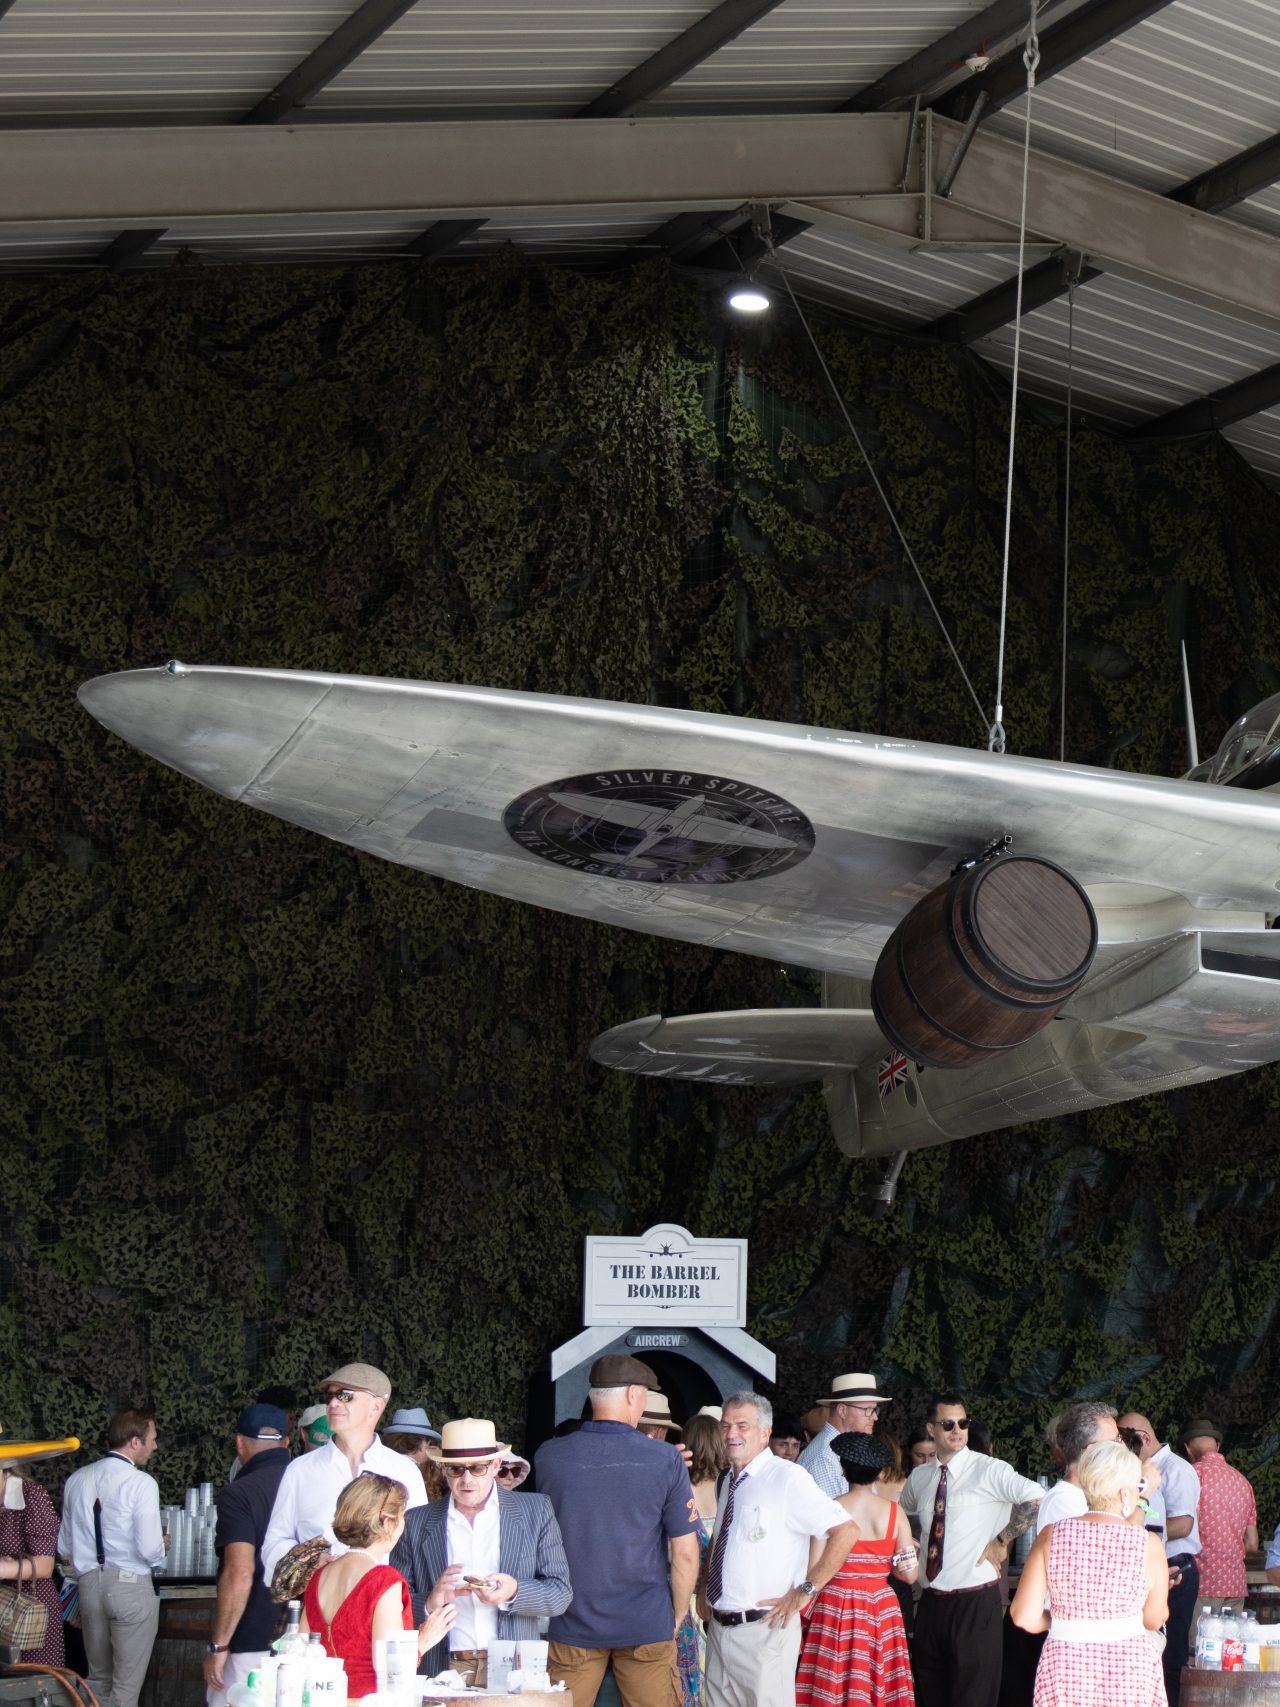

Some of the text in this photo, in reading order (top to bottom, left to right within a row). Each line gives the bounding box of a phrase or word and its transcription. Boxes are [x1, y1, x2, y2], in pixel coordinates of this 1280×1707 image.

[595, 771, 801, 824] SILVER SPITFIRE
[514, 829, 549, 848] THE
[541, 848, 648, 880] LONGEST
[610, 1265, 720, 1280] THE BARREL
[627, 1284, 701, 1299] BOMBER
[634, 1334, 682, 1347] AIRCREW
